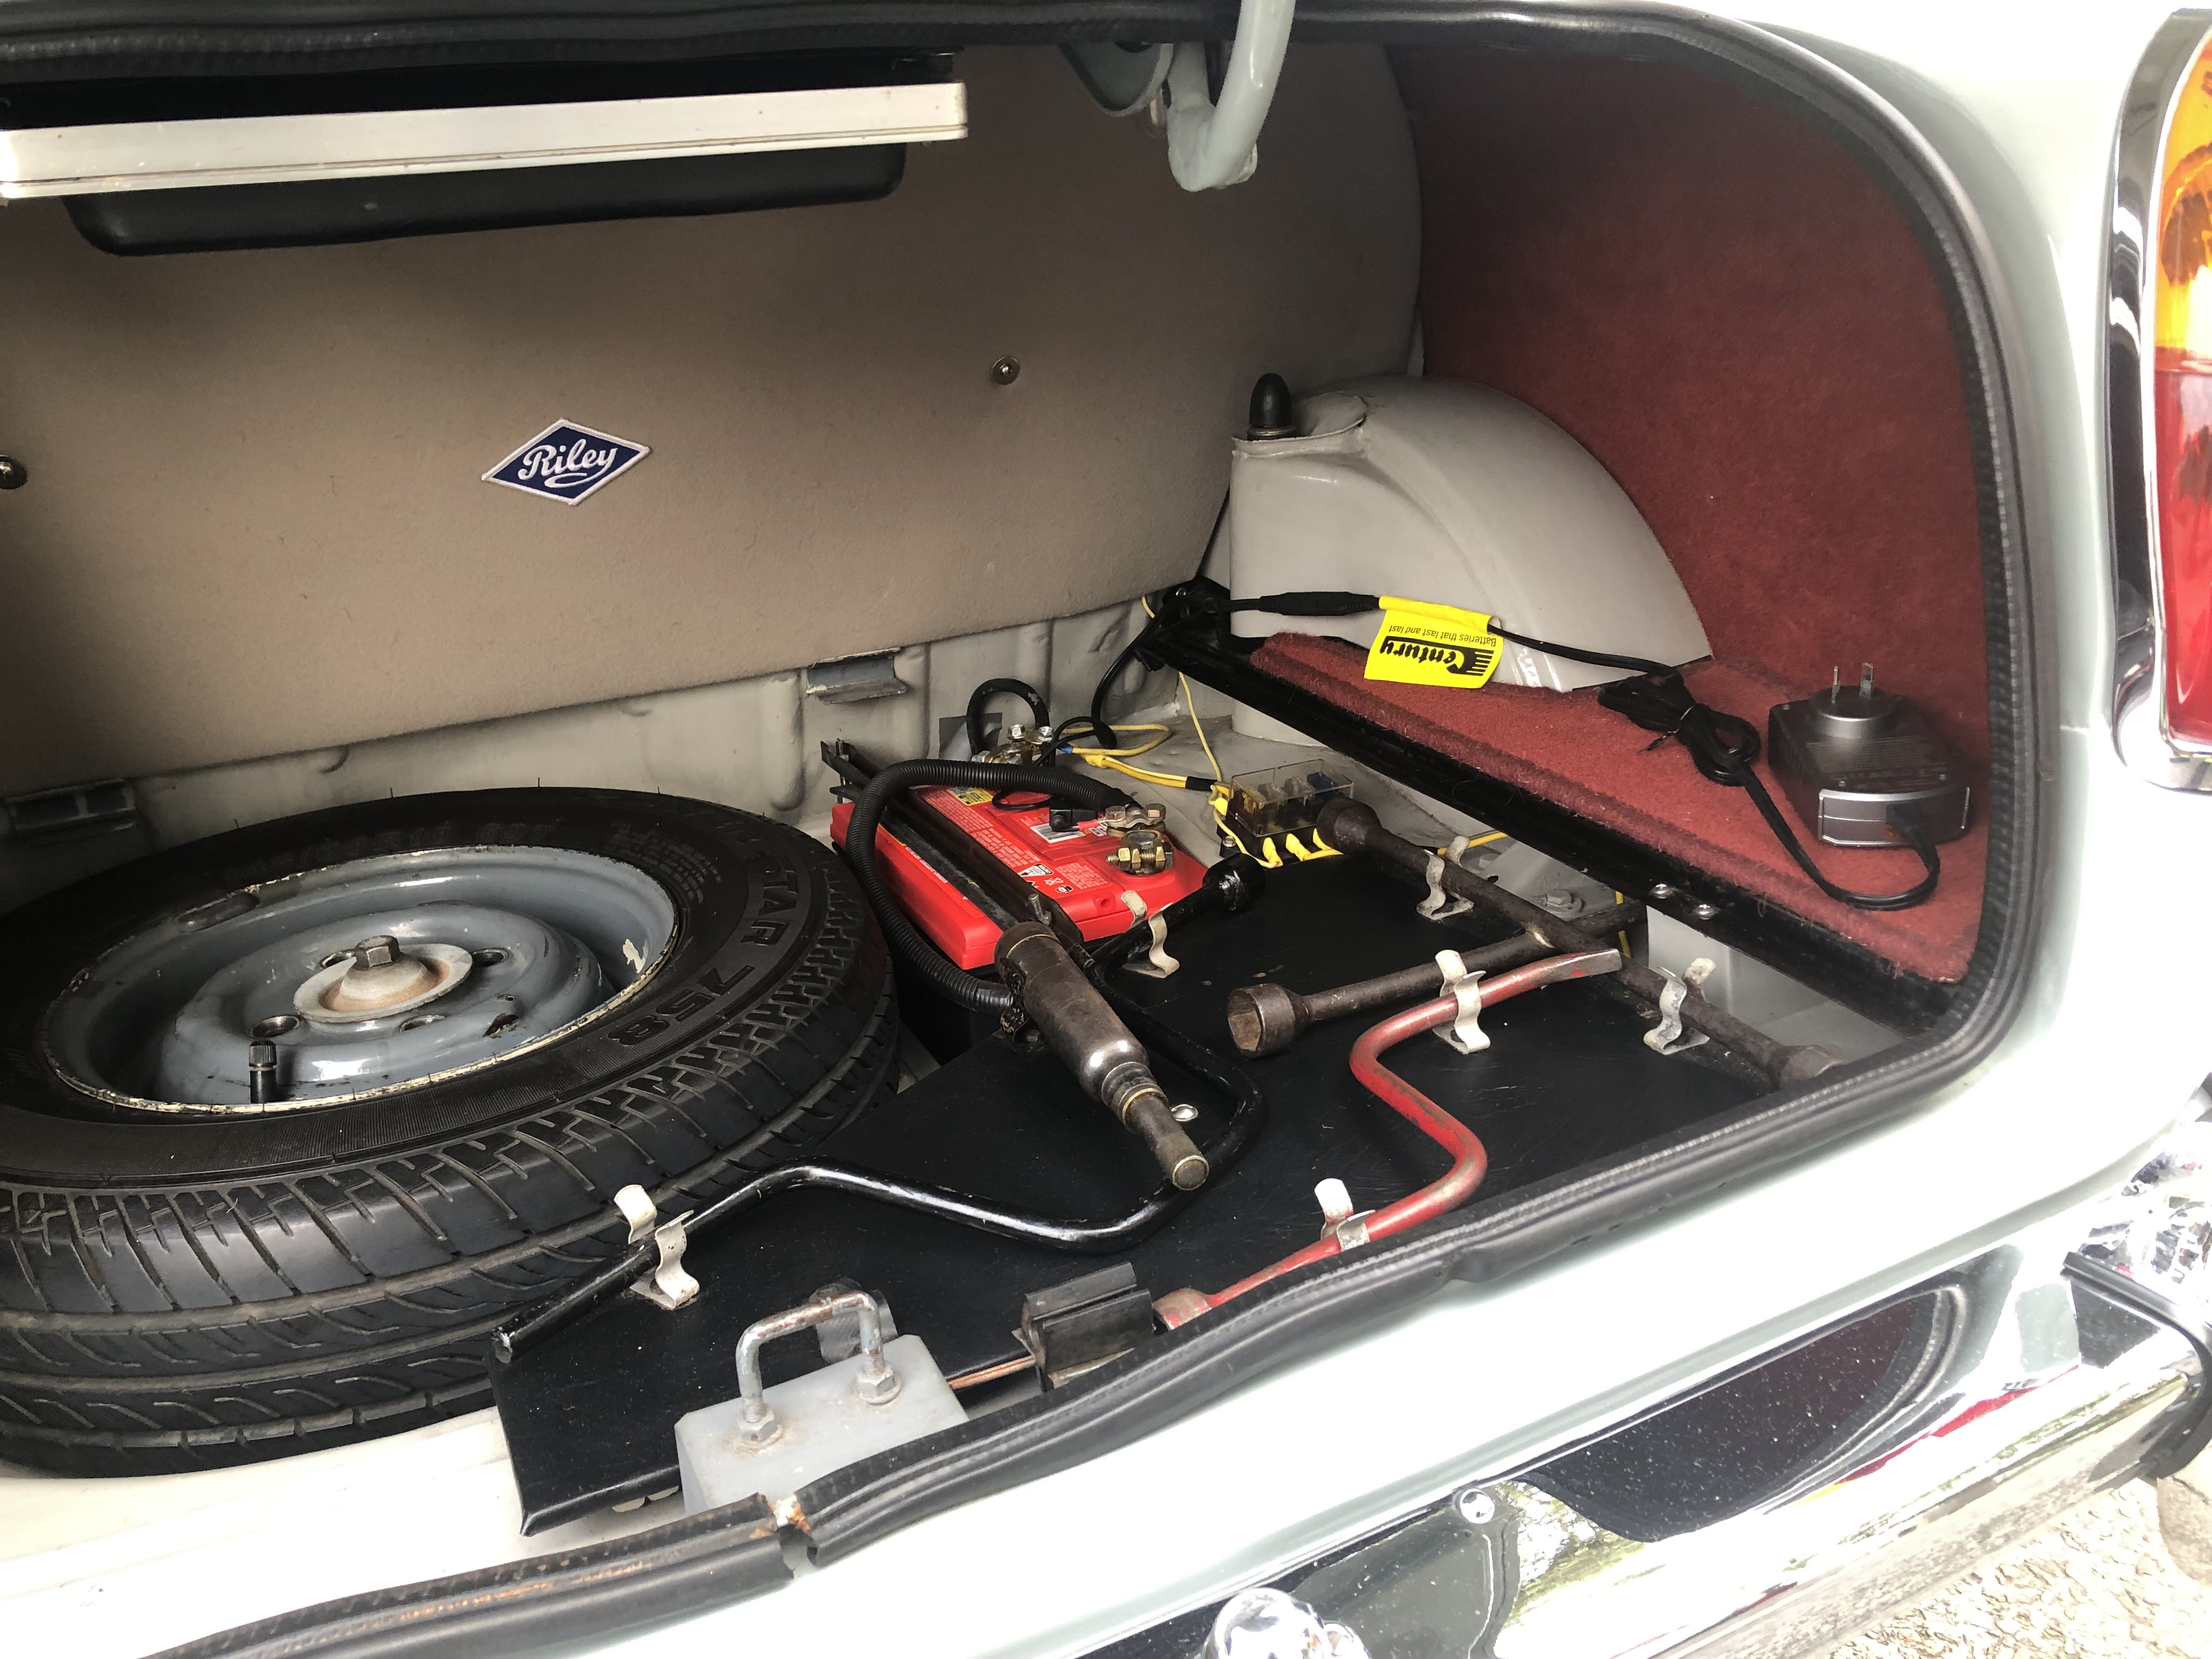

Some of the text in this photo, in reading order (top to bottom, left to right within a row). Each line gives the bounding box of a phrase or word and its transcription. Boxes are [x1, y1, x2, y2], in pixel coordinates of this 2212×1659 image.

[518, 438, 618, 488] Riley
[1389, 625, 1404, 634] last
[1423, 629, 1439, 639] last
[1440, 631, 1457, 641] that
[1459, 634, 1497, 647] Batteries
[1379, 635, 1494, 677] Century
[607, 964, 756, 1047] 758
